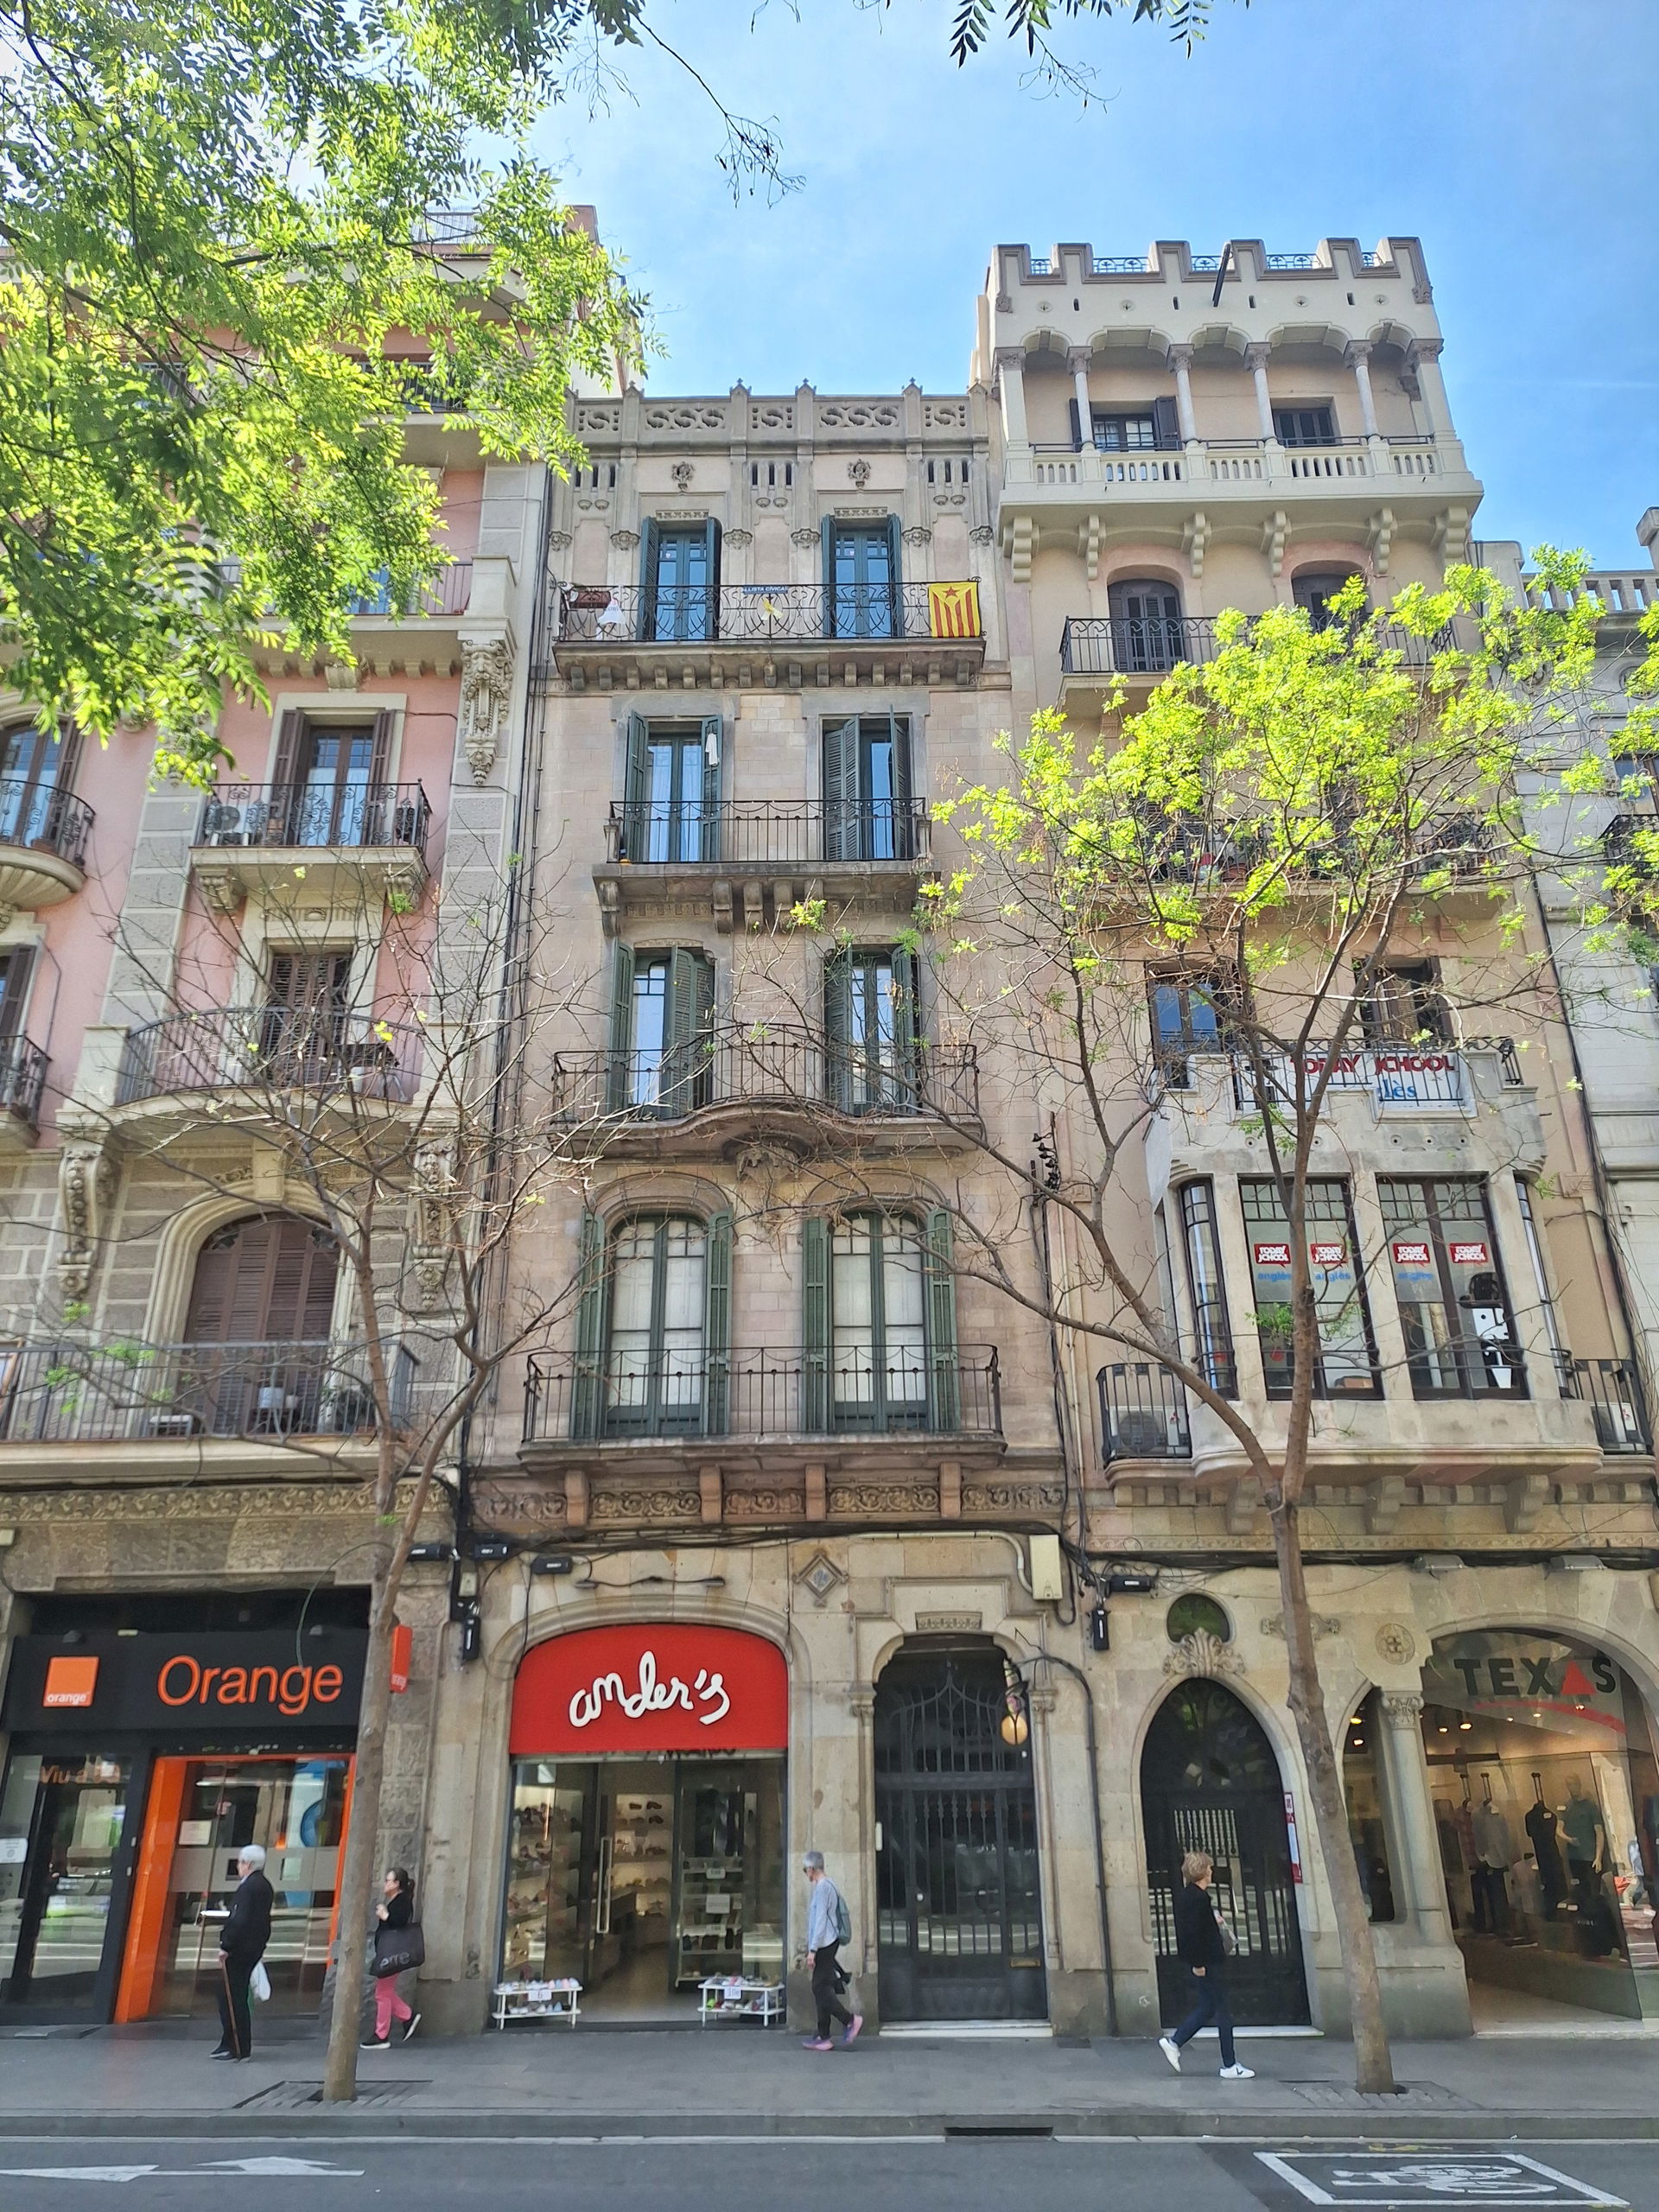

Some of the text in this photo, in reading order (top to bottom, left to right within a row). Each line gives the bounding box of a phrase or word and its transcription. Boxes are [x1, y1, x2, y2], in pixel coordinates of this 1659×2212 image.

[1315, 1271, 1351, 1282] aglès
[156, 1655, 344, 1716] Orange
[569, 1651, 731, 1727] ander's
[1453, 1655, 1616, 1696] TEXAS
[48, 1694, 87, 1706] orange
